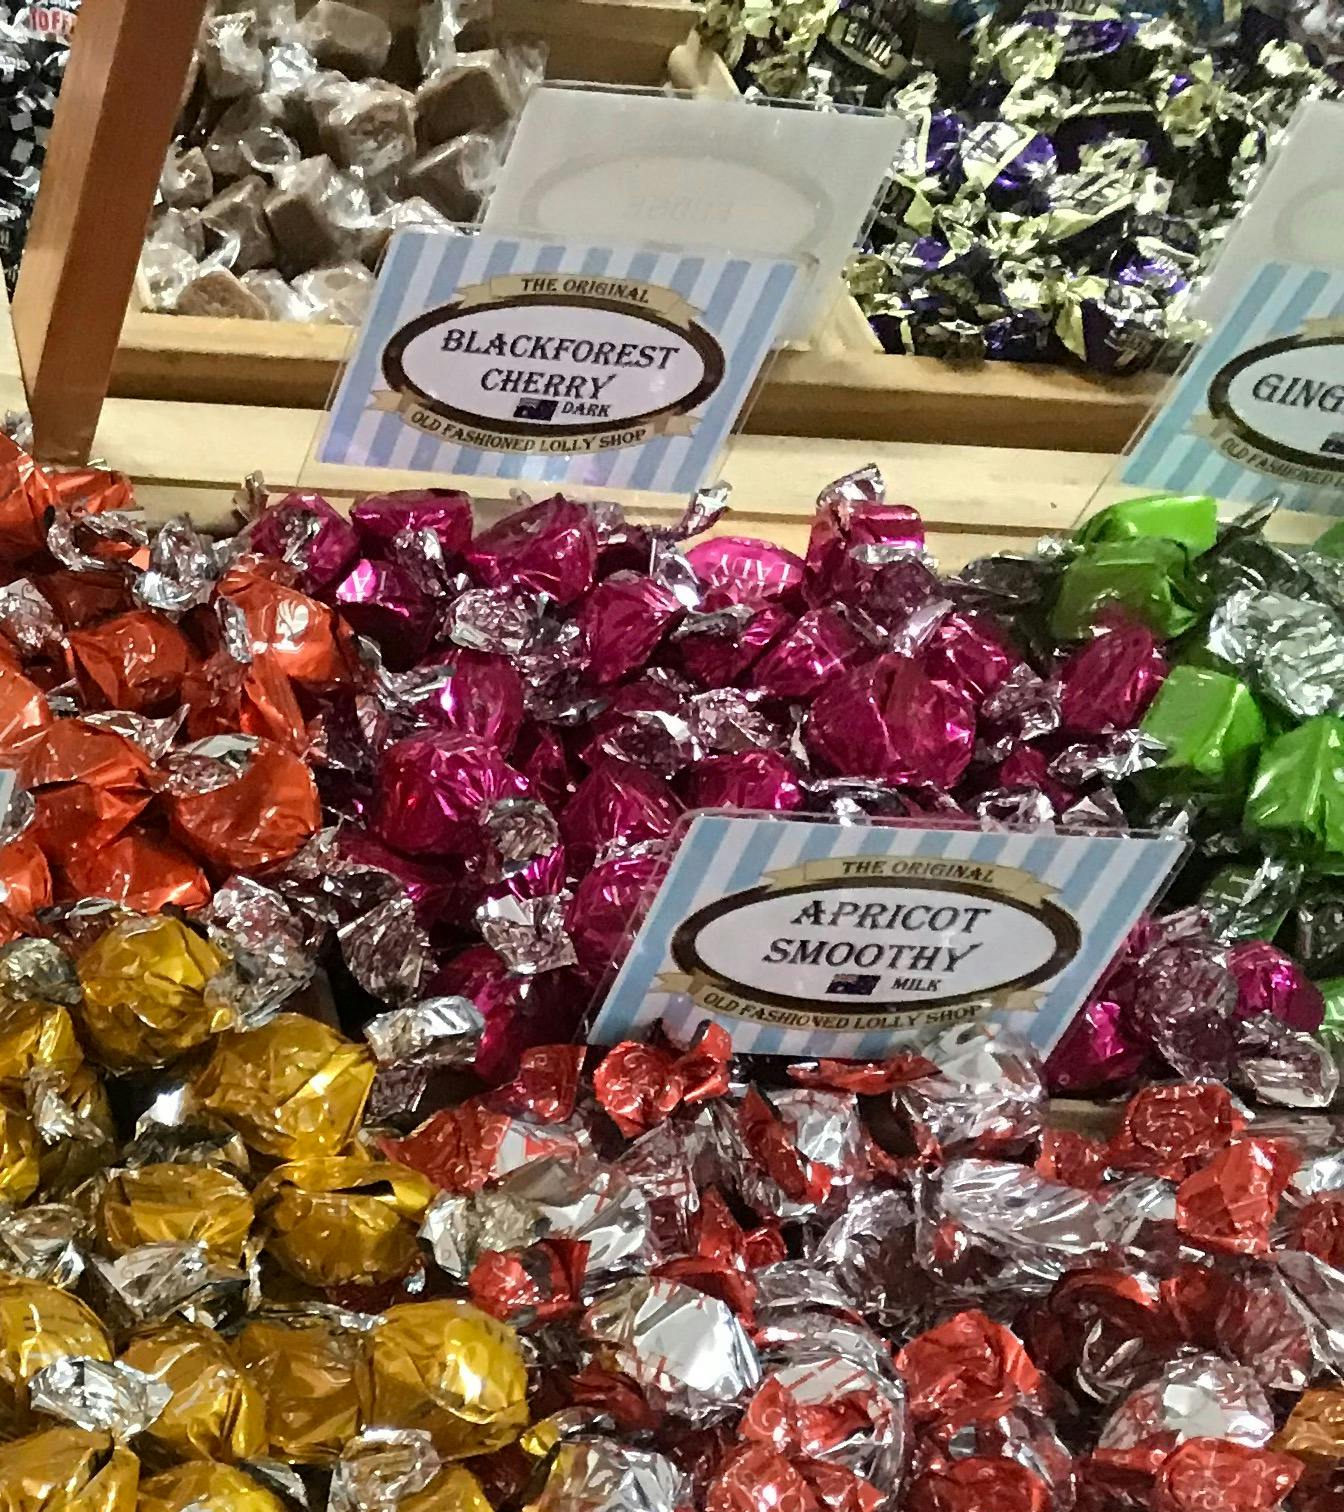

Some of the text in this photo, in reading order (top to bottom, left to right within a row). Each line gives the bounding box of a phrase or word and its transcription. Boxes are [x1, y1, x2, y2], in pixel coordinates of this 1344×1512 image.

[521, 278, 650, 304] THE ORIGINAL
[441, 329, 679, 371] BLACKFOREST
[481, 367, 616, 401] CHERRY
[561, 402, 611, 418] DARK
[411, 410, 647, 452] OLD FASHIONED LOLLY SHOP
[842, 861, 995, 884] THE ORIGINAL
[790, 899, 991, 935] APRICOT
[762, 938, 979, 973] SMOOTHY
[891, 977, 942, 992] MILK
[703, 991, 983, 1030] OLD FASHIONED LOLLY SHOP
